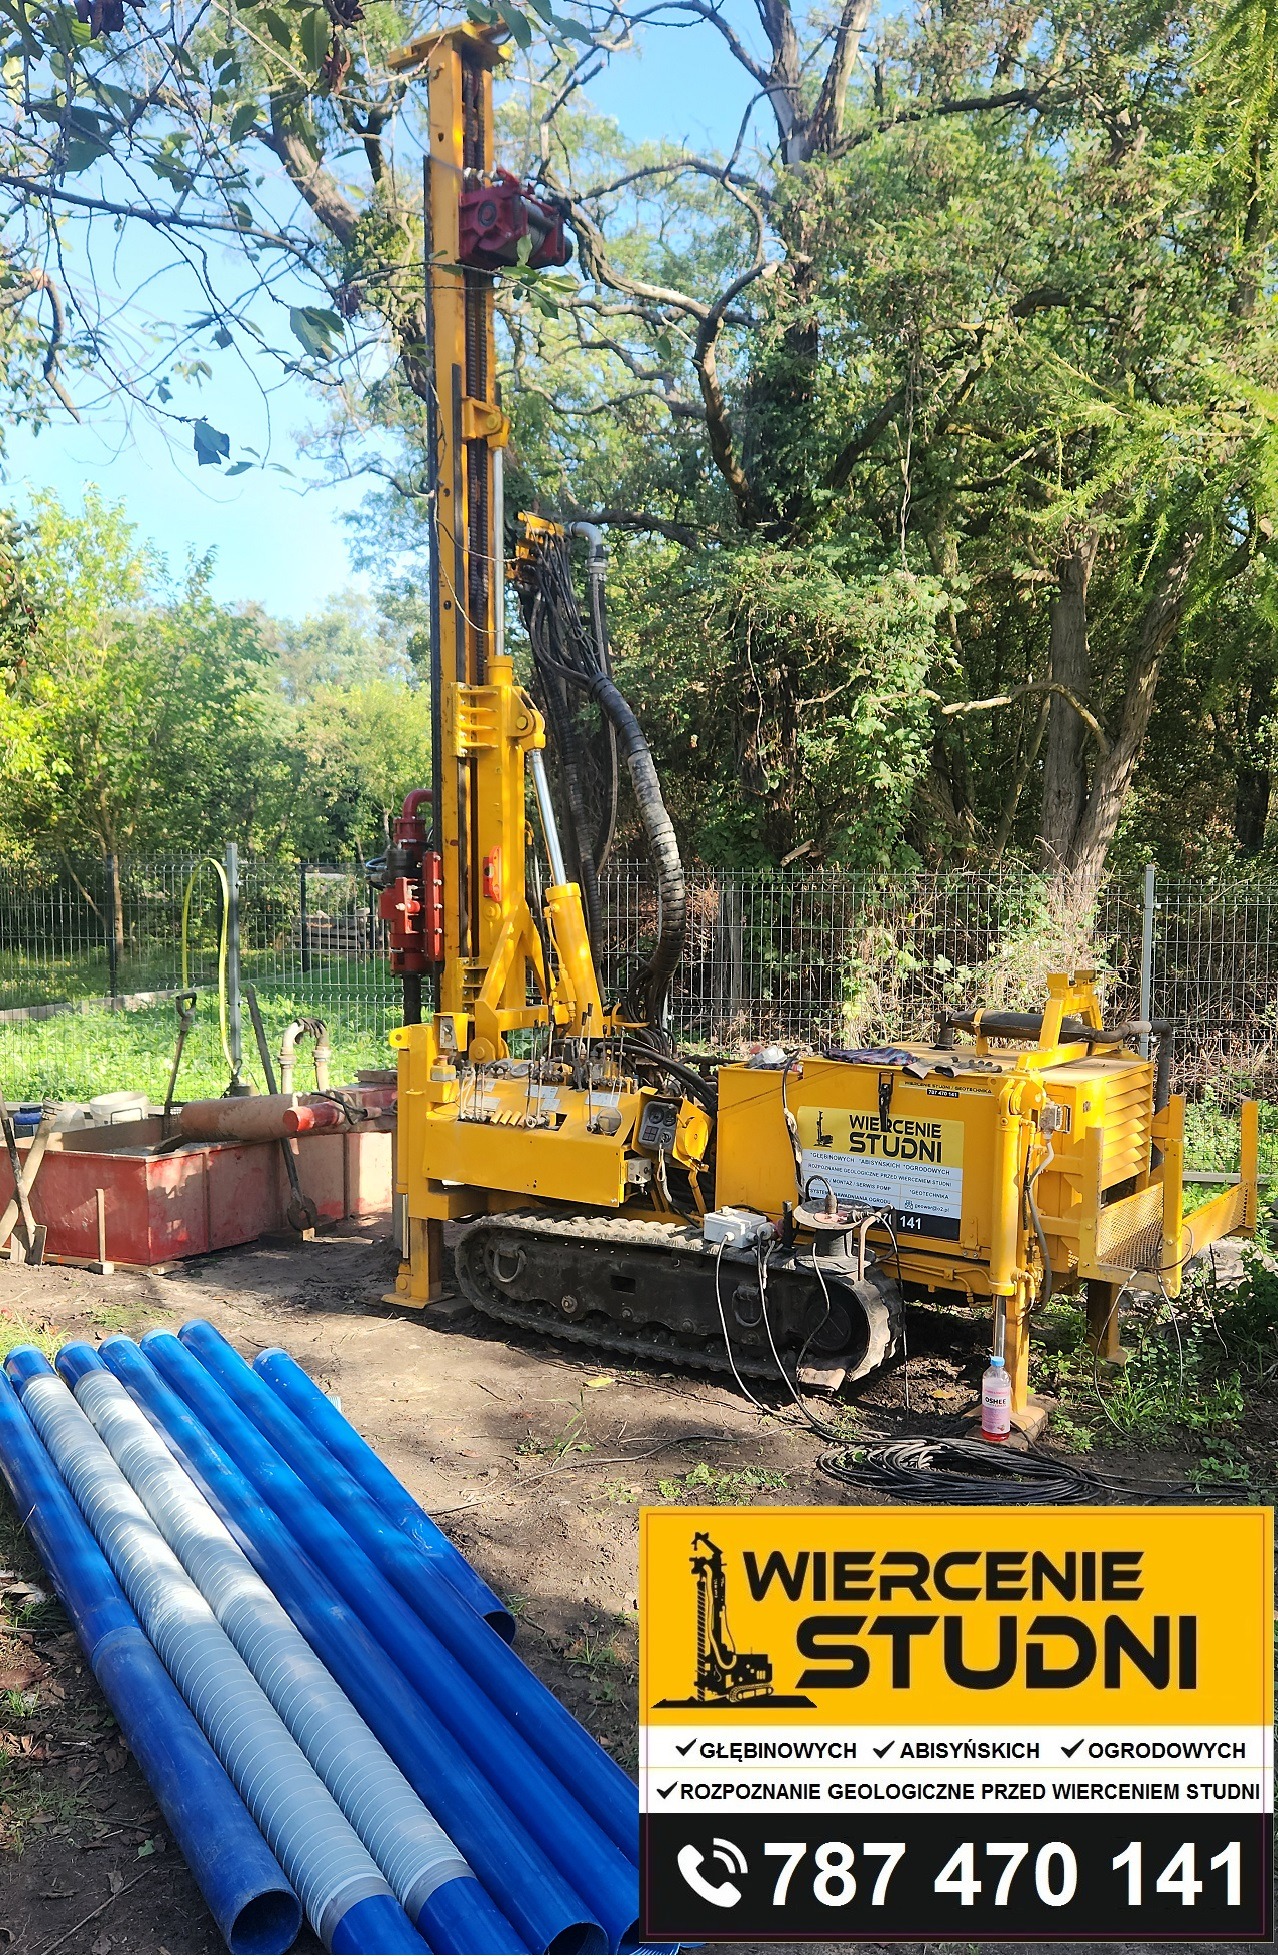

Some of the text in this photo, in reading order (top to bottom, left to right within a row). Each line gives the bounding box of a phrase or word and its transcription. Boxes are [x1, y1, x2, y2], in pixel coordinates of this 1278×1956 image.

[849, 1114, 942, 1139] WIERCENIE
[849, 1132, 942, 1163] STUDNI
[898, 1175, 931, 1184] WIERCENIEM
[900, 1215, 921, 1230] 141
